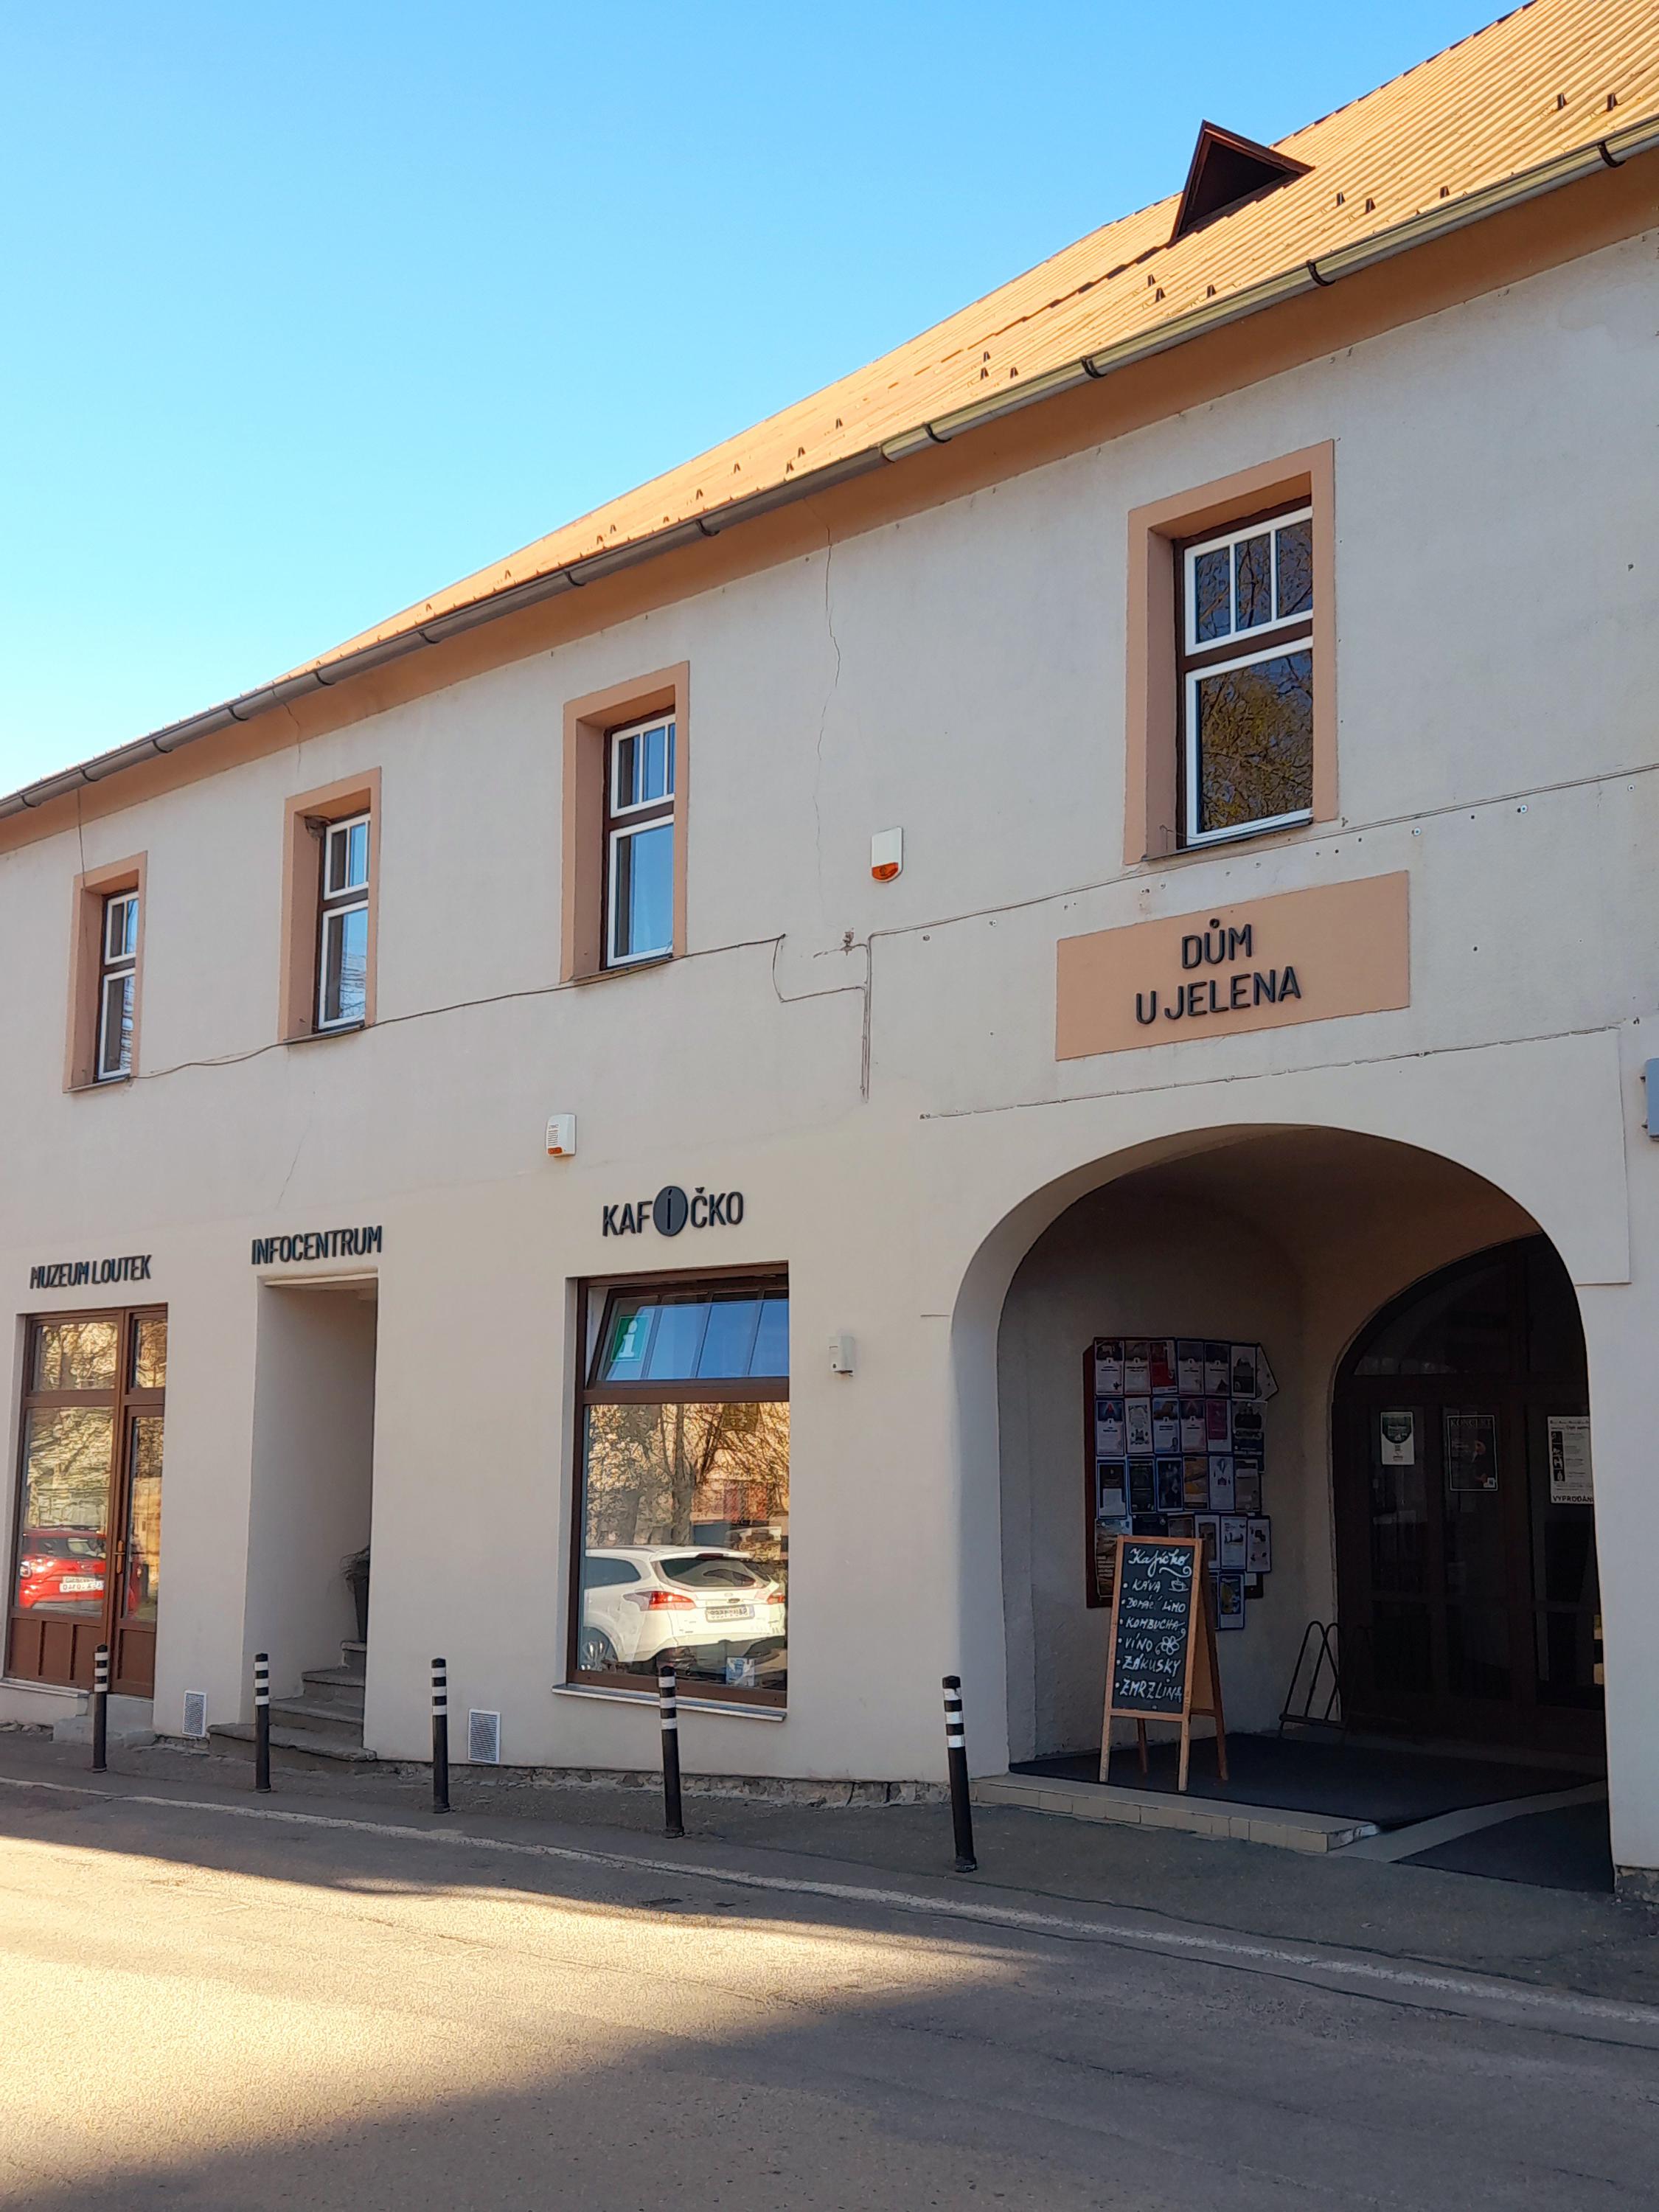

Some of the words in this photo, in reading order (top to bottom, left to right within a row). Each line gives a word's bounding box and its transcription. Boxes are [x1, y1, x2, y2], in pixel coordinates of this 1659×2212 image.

[1182, 918, 1252, 969] DŮM
[1136, 990, 1157, 1024] U
[1164, 966, 1301, 1020] JELENA
[602, 1186, 743, 1237] KAFÍČKO
[251, 1225, 382, 1265] INFOCENTRUM
[29, 1260, 90, 1289] MUZEUM
[91, 1254, 152, 1284] LOUTEK
[1132, 1578, 1161, 1593] KÁVA
[1125, 1616, 1185, 1630] KOMBUCHA
[1125, 1632, 1153, 1652] VÍNO
[1121, 1653, 1181, 1677] ZÁKUSKY
